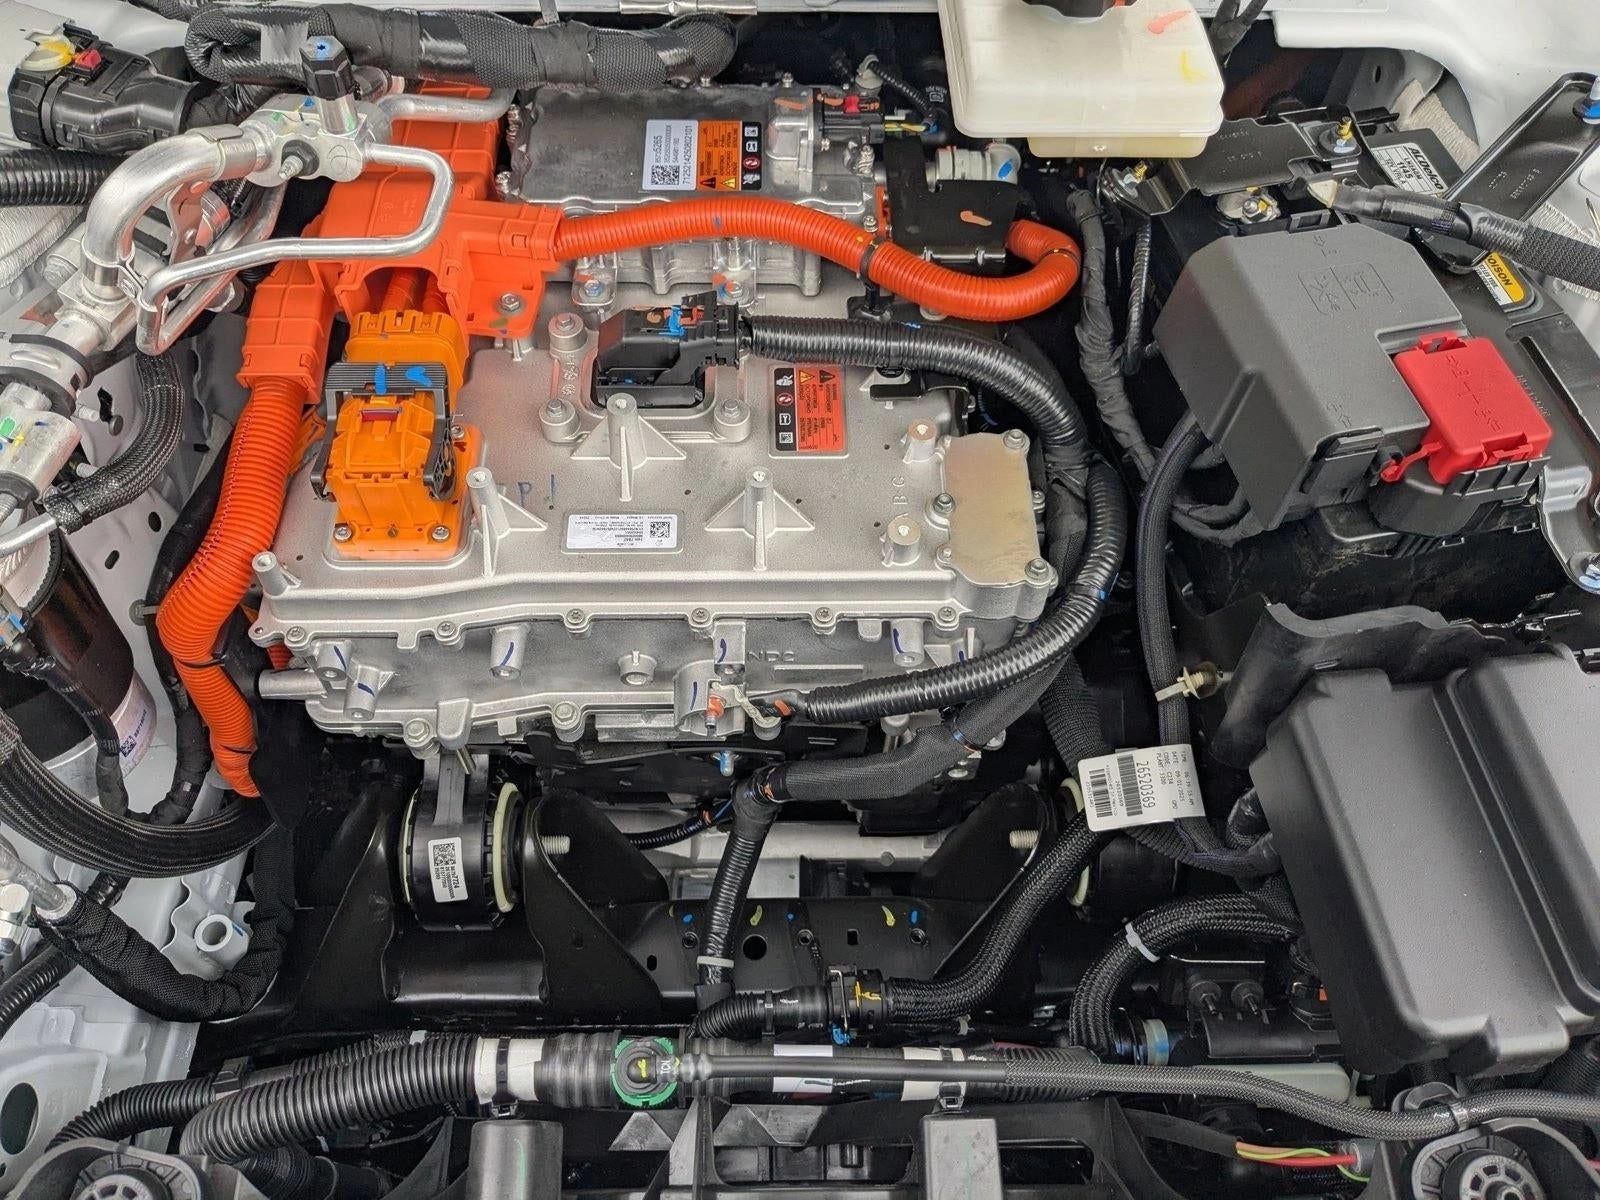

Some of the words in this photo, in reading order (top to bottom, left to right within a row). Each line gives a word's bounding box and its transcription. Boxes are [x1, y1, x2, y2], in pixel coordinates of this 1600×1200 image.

[1397, 161, 1414, 179] 1145
[1408, 147, 1444, 190] ACDelco
[1488, 255, 1513, 285] OISON
[1136, 761, 1156, 808] 26520369
[660, 1060, 671, 1075] TCN
